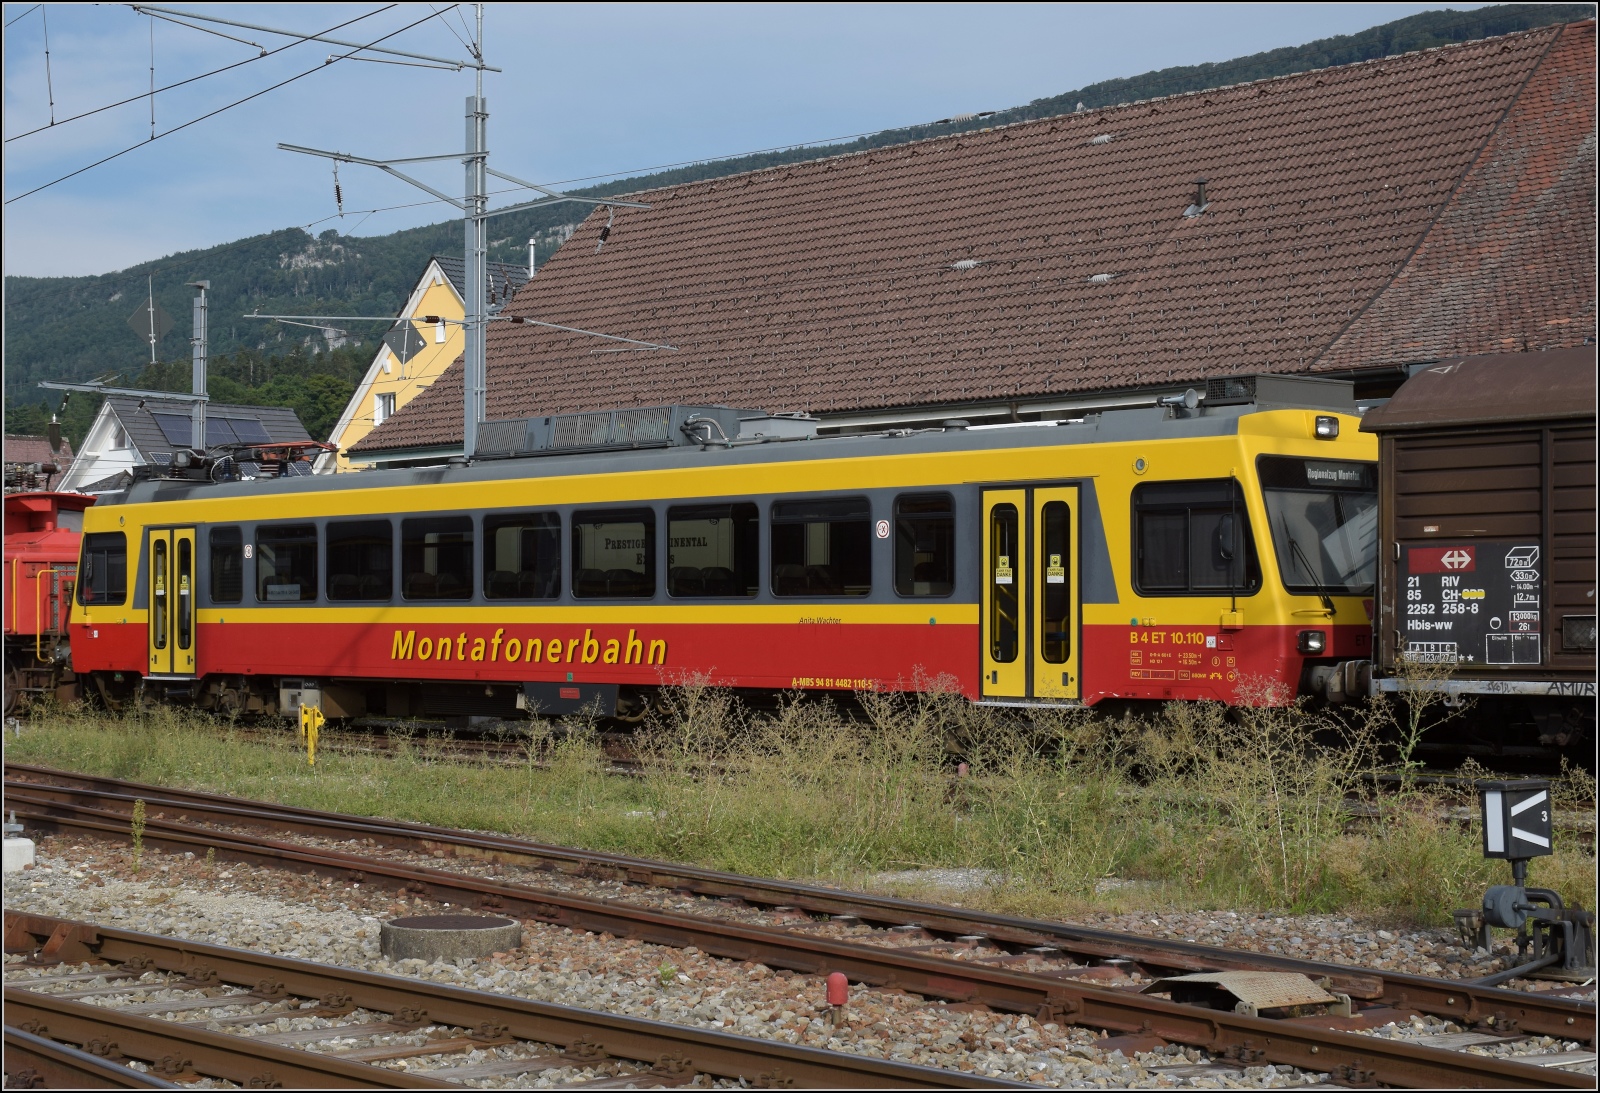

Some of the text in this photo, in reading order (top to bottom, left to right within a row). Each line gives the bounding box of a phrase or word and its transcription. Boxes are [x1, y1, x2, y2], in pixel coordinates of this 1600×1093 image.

[1407, 576, 1460, 587] 21 RIV
[1407, 590, 1422, 600] 85
[1407, 603, 1479, 614] 2252 258-8
[1407, 620, 1453, 631] Hbis-ww
[1518, 622, 1530, 631] 26t
[1130, 632, 1204, 645] B 4 ET 10.110
[391, 628, 667, 665] Montafonerbahn
[792, 678, 873, 689] A-MBS 94 81 4482 110-5
[1541, 811, 1548, 822] 3
